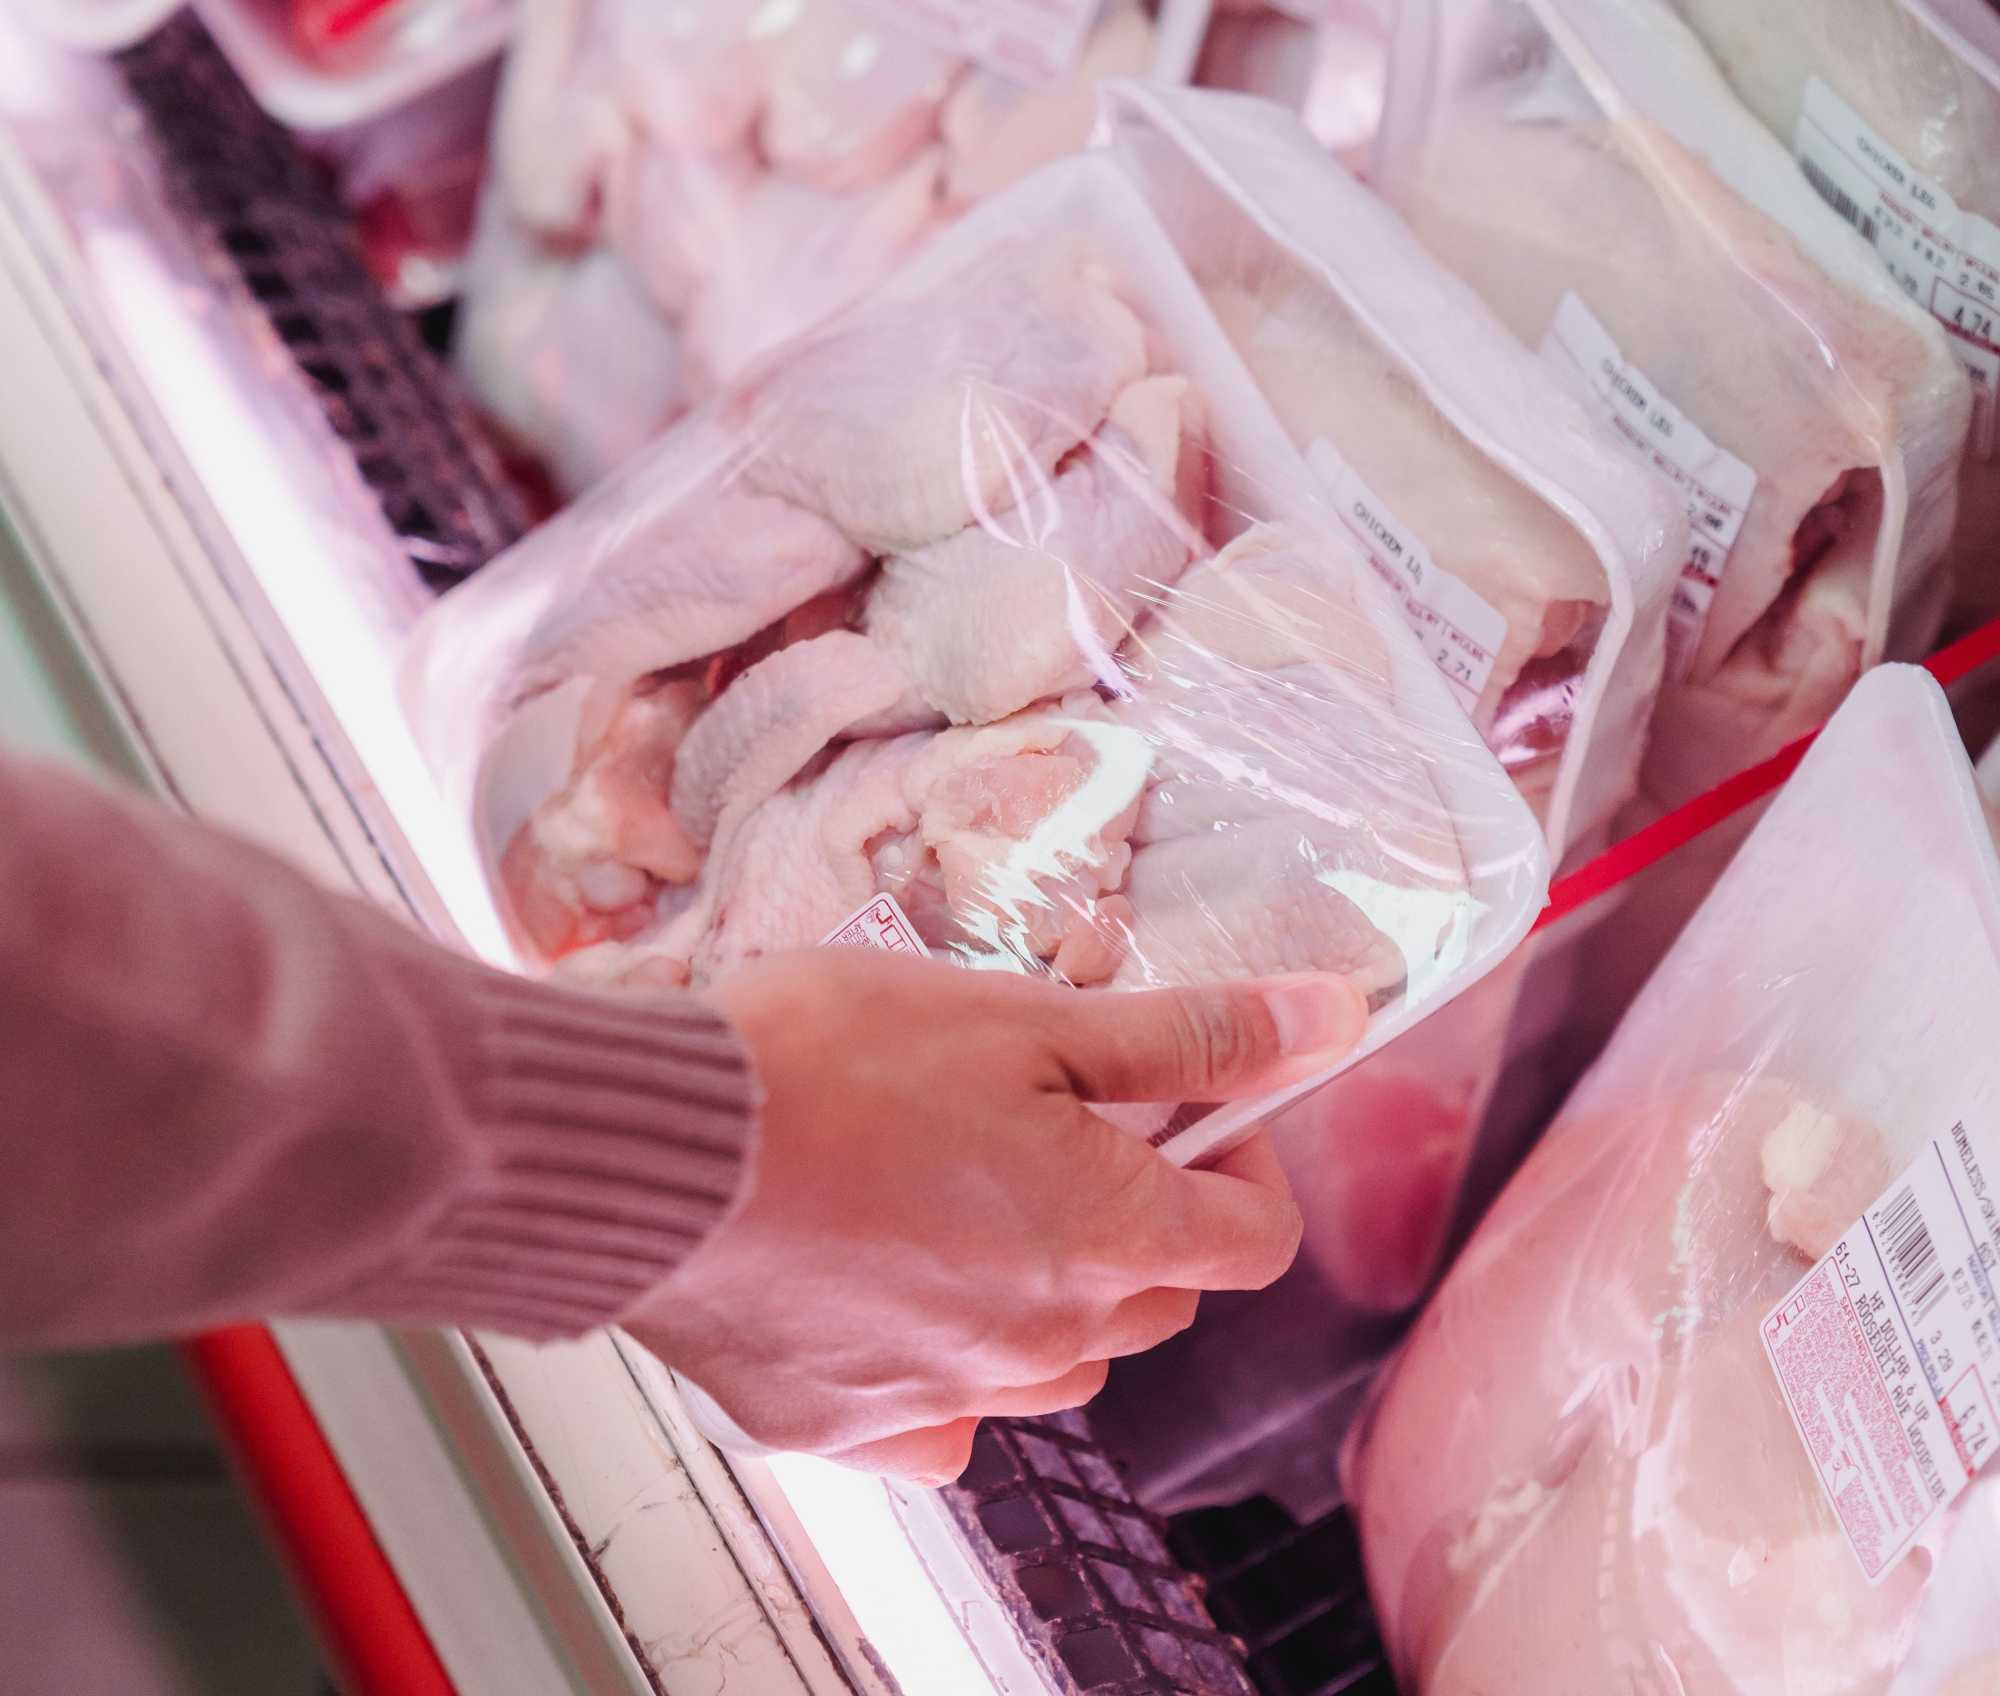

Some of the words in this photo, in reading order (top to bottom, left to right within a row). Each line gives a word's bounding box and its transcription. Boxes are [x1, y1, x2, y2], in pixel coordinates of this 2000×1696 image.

[1835, 1241, 1861, 1288] 61-27
[1855, 1293, 1896, 1380] ROOSEVELT
[1891, 1384, 1912, 1419] AVE
[1907, 1422, 1947, 1502] WOODSIDE
[1870, 1290, 1886, 1313] HF
[1880, 1318, 1912, 1380] DOLLAR
[1915, 1400, 1930, 1422] UP
